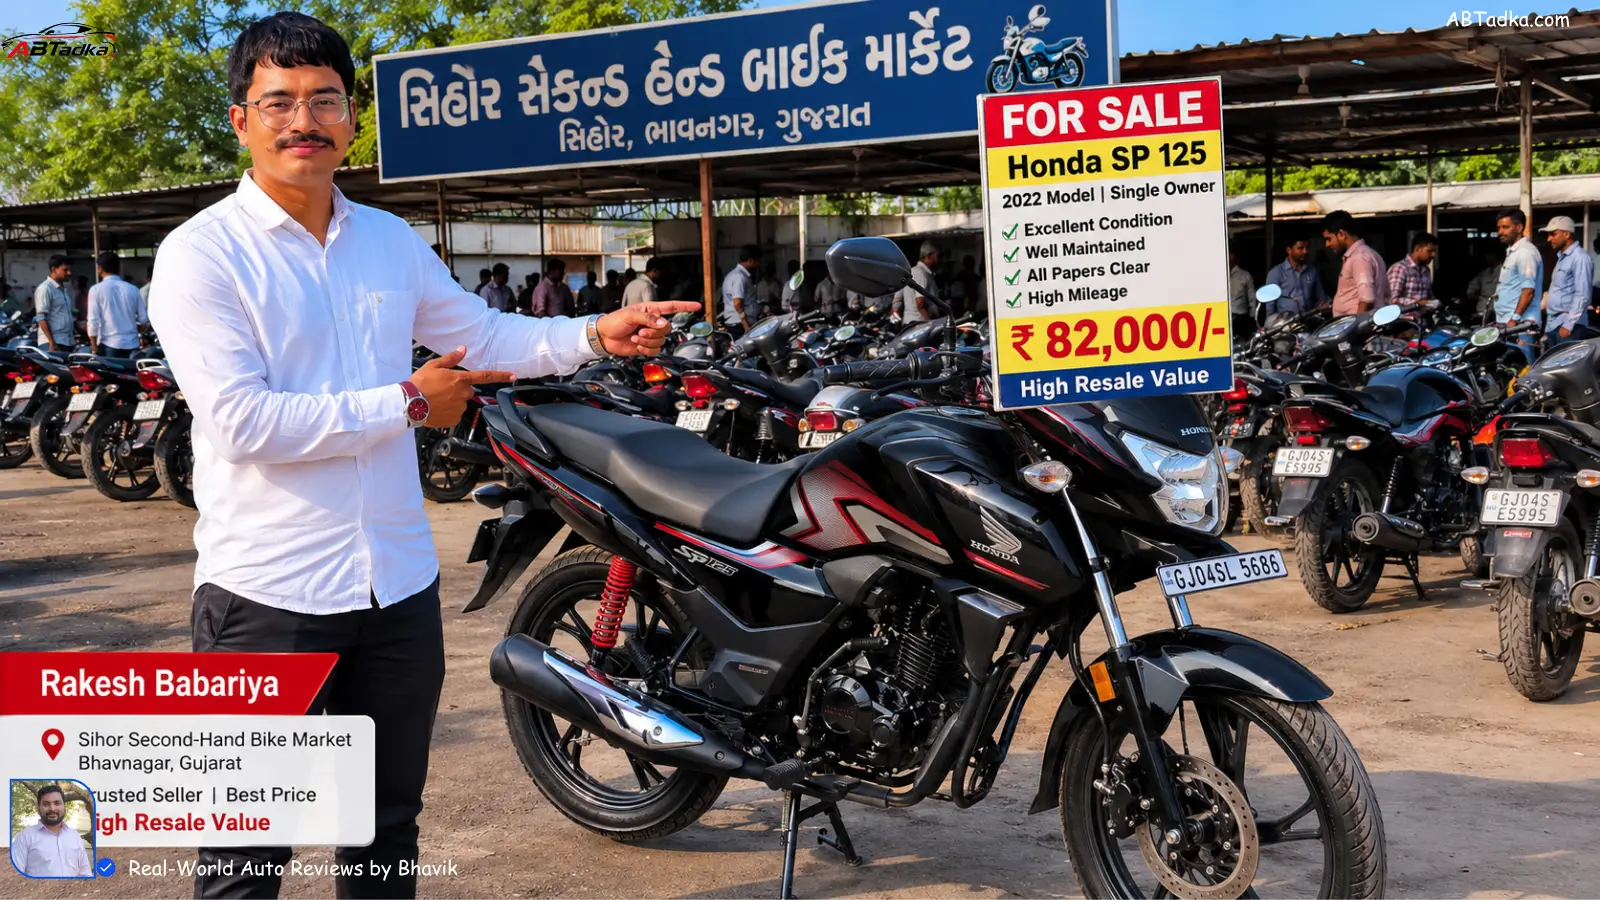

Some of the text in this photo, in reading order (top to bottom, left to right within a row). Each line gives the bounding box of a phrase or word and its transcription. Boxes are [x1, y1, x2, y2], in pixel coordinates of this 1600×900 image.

[399, 7, 974, 129] સિહોર સેકન્ડ હેન્ડ બાઈક માર્કેટ
[559, 101, 872, 152] સિહોર, ભાવનગર, ગુજરાત
[1002, 90, 1204, 139] FOR SALE
[1008, 140, 1207, 180] Honda SP 125
[1002, 192, 1042, 209] 2022
[1046, 187, 1095, 205] Model
[1110, 183, 1160, 201] Single
[1164, 180, 1216, 195] Owner
[1024, 212, 1173, 237] Excellent Condition
[1025, 237, 1146, 260] Well Maintained
[1027, 260, 1150, 283] All Papers Clear
[1028, 285, 1129, 307] High Mileage
[1011, 308, 1226, 362] ₹ 82,000/-
[1020, 366, 1210, 400] High Resale Value
[1284, 461, 1322, 474] E5995
[1287, 450, 1325, 462] GJ04S
[1500, 492, 1550, 507] GJ04S
[1497, 507, 1547, 522] E5995
[970, 539, 1020, 565] HONDA
[1173, 553, 1280, 589] GJ04SL 5686
